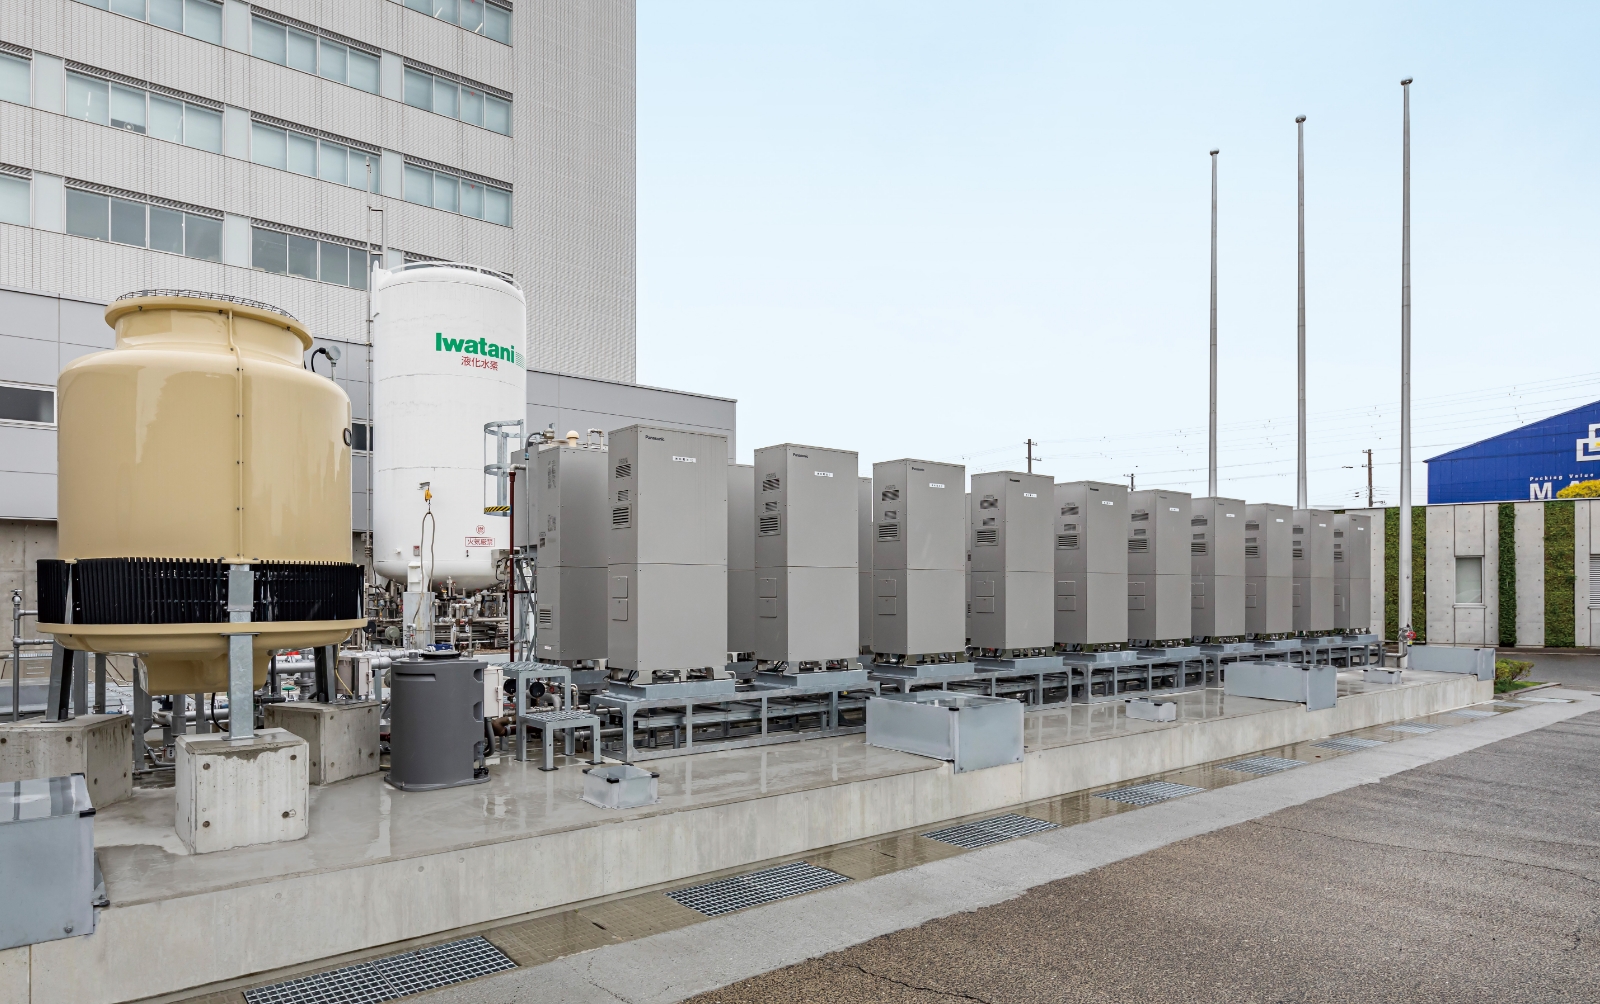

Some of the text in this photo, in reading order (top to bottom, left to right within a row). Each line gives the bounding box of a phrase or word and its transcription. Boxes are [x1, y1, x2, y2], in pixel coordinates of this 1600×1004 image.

[435, 332, 515, 363] Iwatani
[461, 355, 498, 371] 液化水素
[467, 538, 493, 546] 火気厳禁
